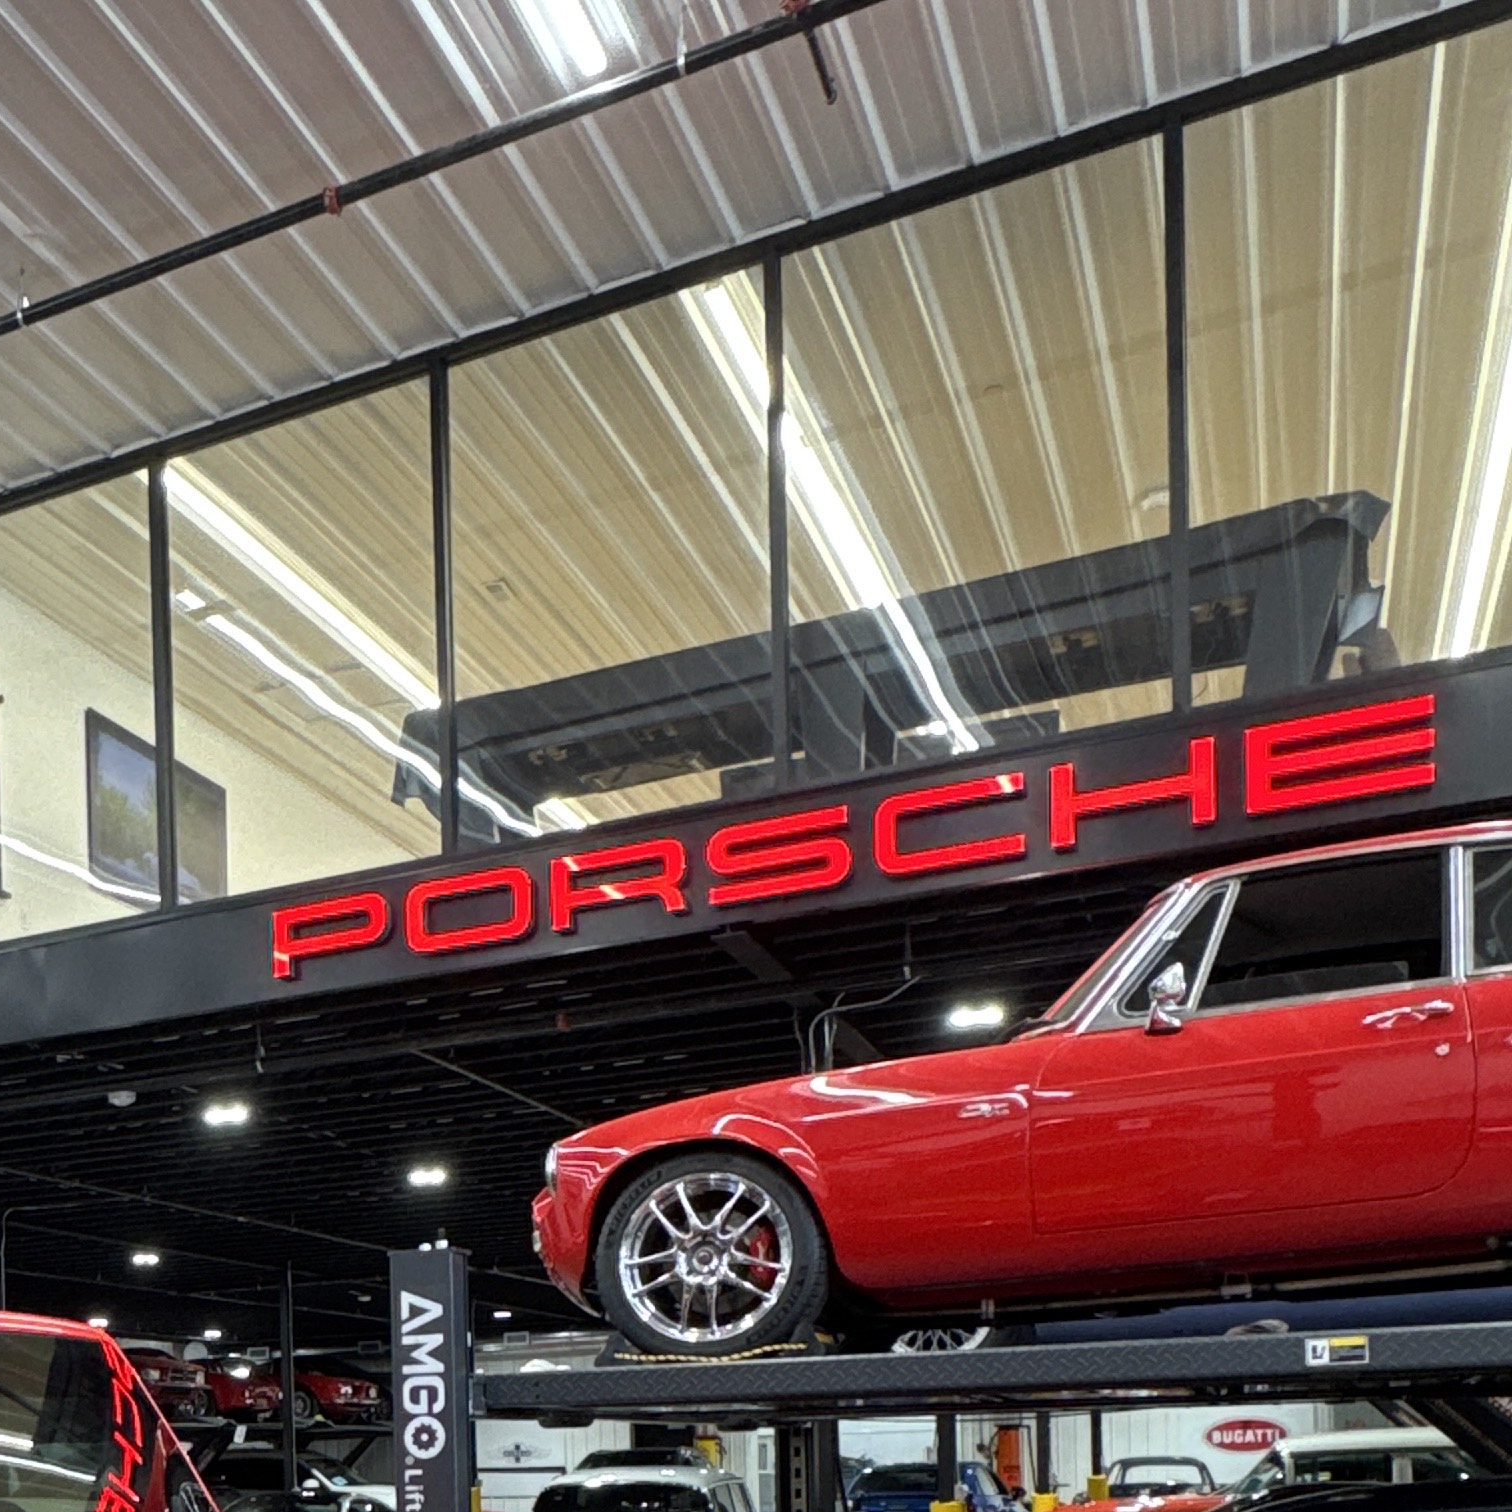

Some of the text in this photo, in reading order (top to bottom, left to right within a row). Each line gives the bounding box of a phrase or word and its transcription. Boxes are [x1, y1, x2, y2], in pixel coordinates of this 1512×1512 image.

[271, 692, 1437, 980] PORSCHE
[400, 1290, 446, 1461] AMGO
[1211, 1428, 1281, 1444] BUGATTI
